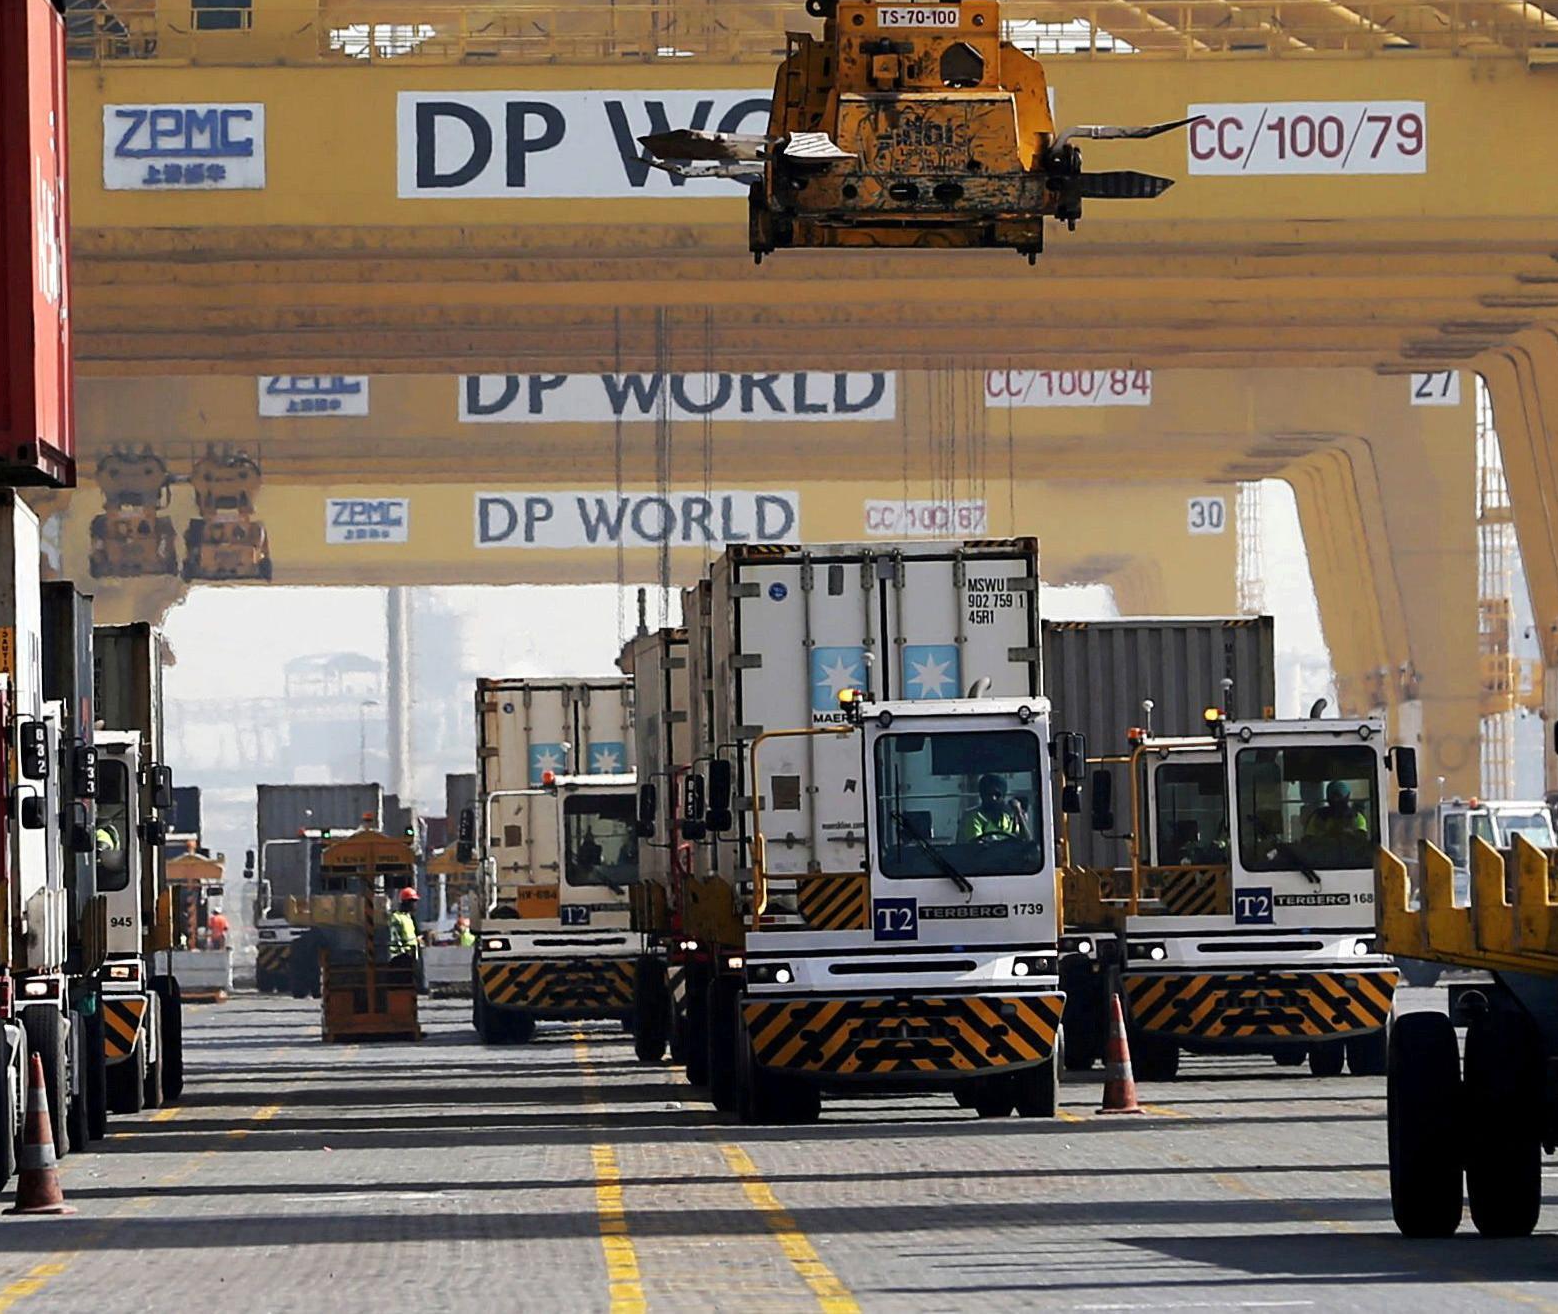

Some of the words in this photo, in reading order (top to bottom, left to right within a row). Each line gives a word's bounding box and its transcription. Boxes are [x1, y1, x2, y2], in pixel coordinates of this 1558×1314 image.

[880, 10, 956, 25] TS-70-100
[115, 109, 253, 157] ZPMC
[416, 101, 566, 188] DP
[1190, 107, 1423, 169] CC/100/79
[466, 374, 568, 414] DP
[600, 372, 886, 414] WORLD
[1414, 370, 1454, 398] 27
[332, 502, 403, 526] ZPMC
[479, 496, 554, 542] DP
[577, 494, 795, 542] WORLD
[1191, 502, 1222, 528] 30
[968, 578, 1004, 592] MSWU
[968, 594, 989, 608] 902
[994, 594, 1012, 608] 759
[968, 610, 994, 624] 45R1
[565, 906, 587, 923] T2
[877, 908, 913, 931] T2
[923, 907, 1007, 918] TERBERG
[1012, 904, 1044, 915] 1739
[1238, 896, 1269, 917] T2
[1277, 894, 1349, 905] TERBERG
[1354, 894, 1374, 904] 168
[110, 917, 132, 927] 945
